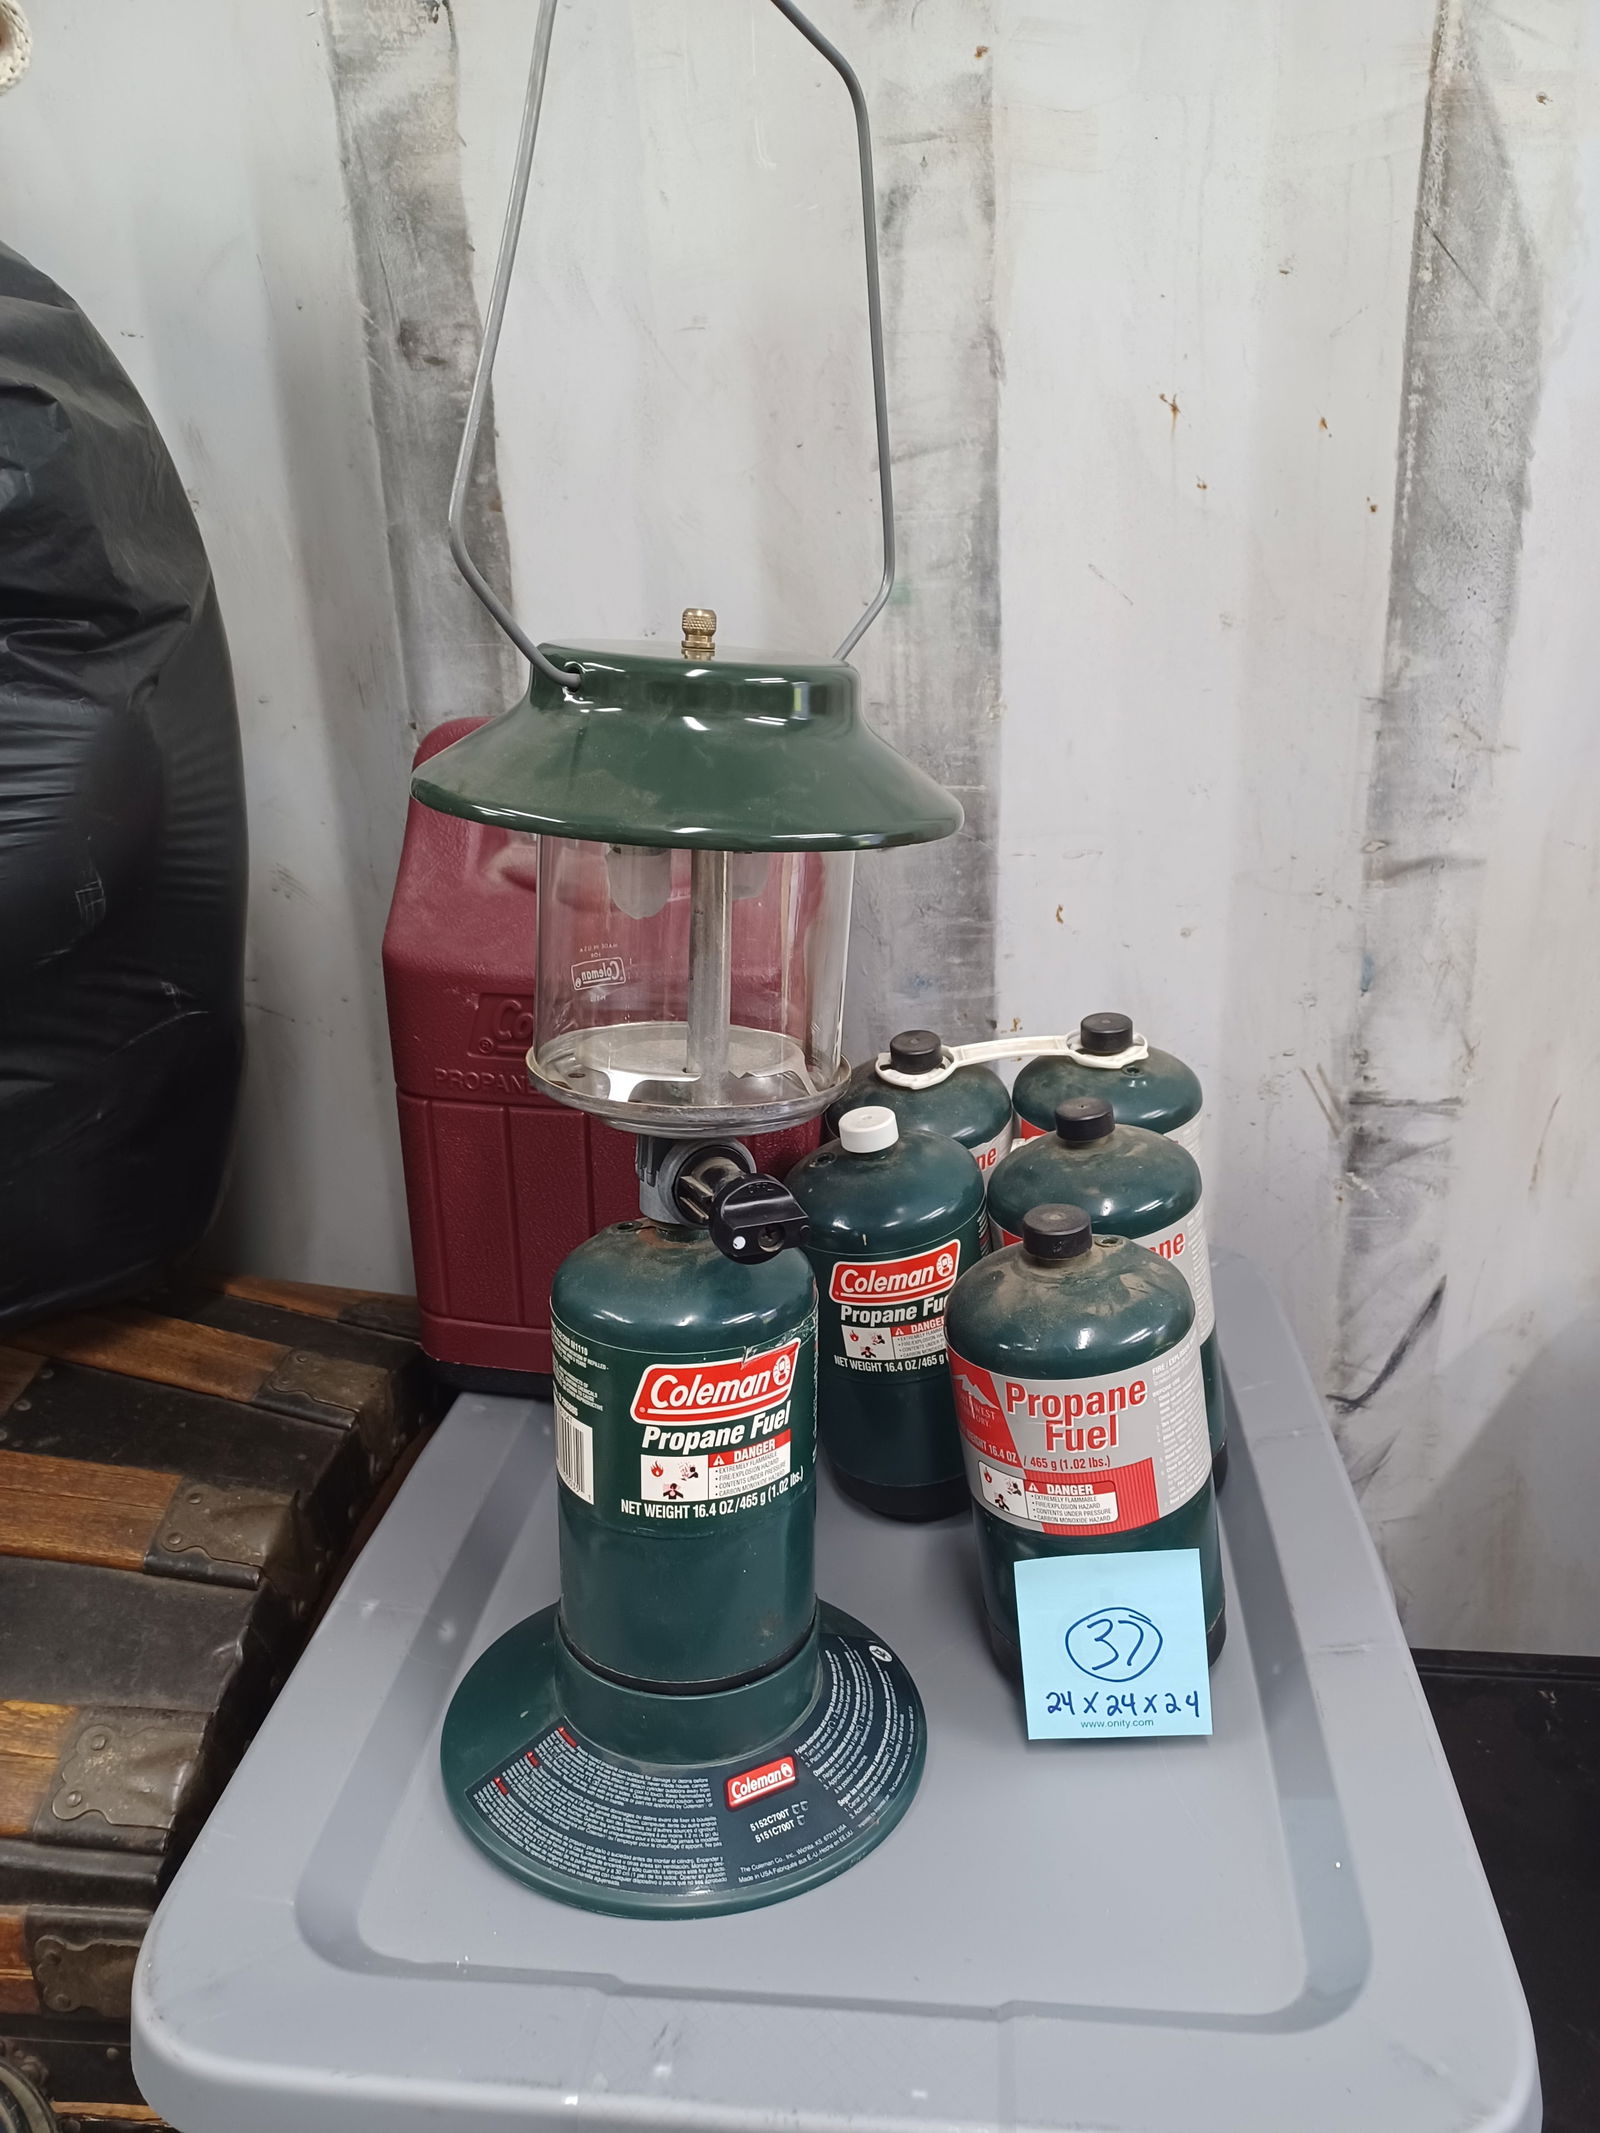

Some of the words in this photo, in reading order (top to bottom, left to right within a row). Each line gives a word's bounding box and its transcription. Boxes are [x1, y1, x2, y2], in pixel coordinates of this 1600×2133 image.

[840, 1266, 935, 1293] Coleman
[840, 1304, 917, 1327] Propane
[834, 1355, 848, 1367] NET
[849, 1359, 882, 1372] WEIGHT
[884, 1361, 903, 1372] 16.4
[650, 1369, 771, 1409] Coleman
[1005, 1379, 1147, 1427] Propane
[641, 1424, 746, 1455] Propane
[750, 1400, 791, 1439] Fuel
[1045, 1414, 1119, 1453] Fuel
[733, 1438, 776, 1463] DANGER
[988, 1443, 1004, 1459] 16.4
[1006, 1451, 1018, 1464] OZ
[1030, 1456, 1048, 1468] 465
[1051, 1459, 1058, 1471] g
[1060, 1457, 1086, 1472] (1.02
[1088, 1455, 1111, 1468] lbs.)
[719, 1460, 749, 1474] EXTREMELY
[719, 1464, 760, 1482] FIRE/EXPLOSION
[621, 1499, 641, 1516] NET
[644, 1502, 690, 1519] WEIGHT
[693, 1503, 716, 1518] 16.4
[760, 1492, 766, 1506] g
[768, 1478, 789, 1503] (1.02
[790, 1465, 804, 1488] lbs.)
[719, 1477, 746, 1490] CONTENTS
[748, 1472, 764, 1483] UNDER
[719, 1486, 741, 1497] CARBON
[1046, 1483, 1094, 1496] DANGER
[1035, 1500, 1078, 1509] FIRE/EXPLOSION
[1065, 1495, 1097, 1503] FLAMMABLE
[1036, 1508, 1063, 1516] CONTENTS
[1083, 1508, 1111, 1516] PRESSURE
[1089, 1515, 1111, 1523] HAZARD
[1087, 1618, 1144, 1671] 37
[1046, 1690, 1075, 1715] 24
[1106, 1692, 1138, 1717] 24
[1165, 1690, 1200, 1718] 24
[1080, 1718, 1154, 1729] www.onity.com
[731, 1769, 783, 1799] Coleman
[749, 1808, 790, 1832] 5152C700T
[754, 1819, 795, 1843] 5151C700T
